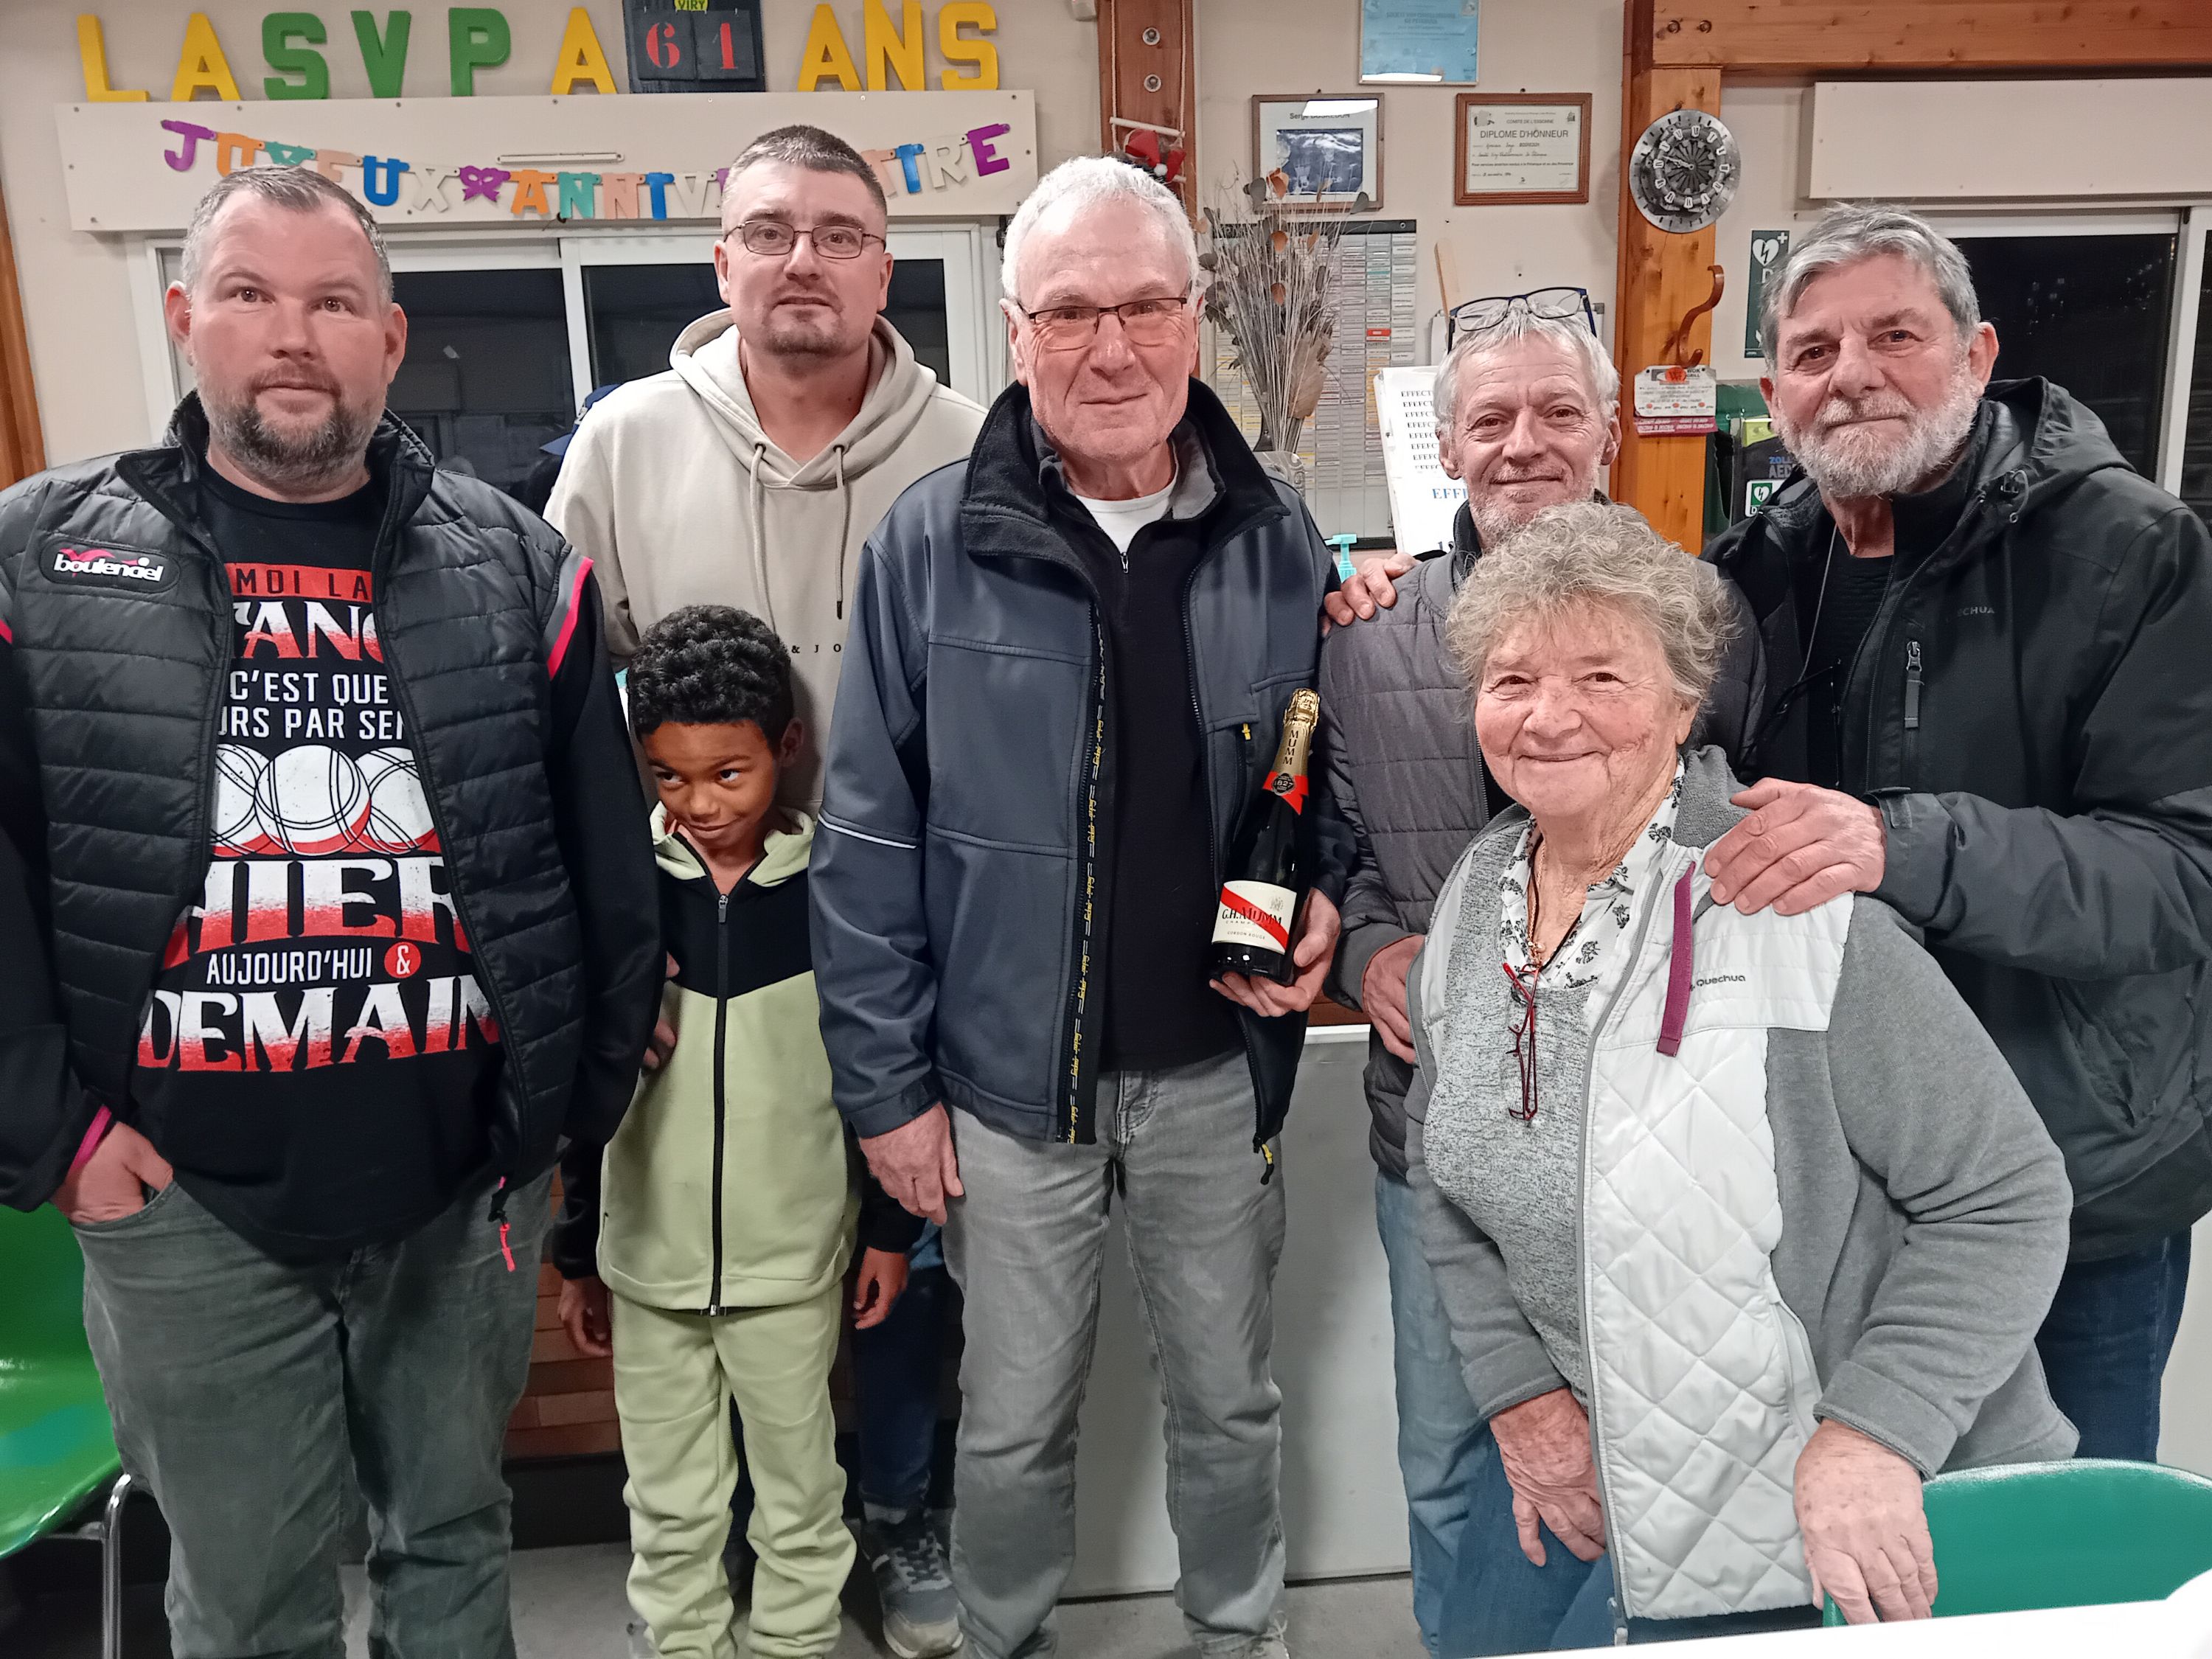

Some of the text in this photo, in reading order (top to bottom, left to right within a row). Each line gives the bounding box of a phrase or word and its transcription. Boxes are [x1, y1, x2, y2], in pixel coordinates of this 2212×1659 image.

[551, 6, 617, 94] A
[796, 0, 998, 91] ANS
[1480, 130, 1517, 139] DIPLOME
[235, 568, 369, 601] MOI LA
[229, 669, 389, 707] C'EST QUE
[285, 708, 345, 740] PAR
[1282, 729, 1299, 765] MUMM
[1248, 932, 1265, 940] ROUGE
[206, 945, 411, 986] AUJOURD'HUI &
[1696, 975, 1746, 987] Quechua
